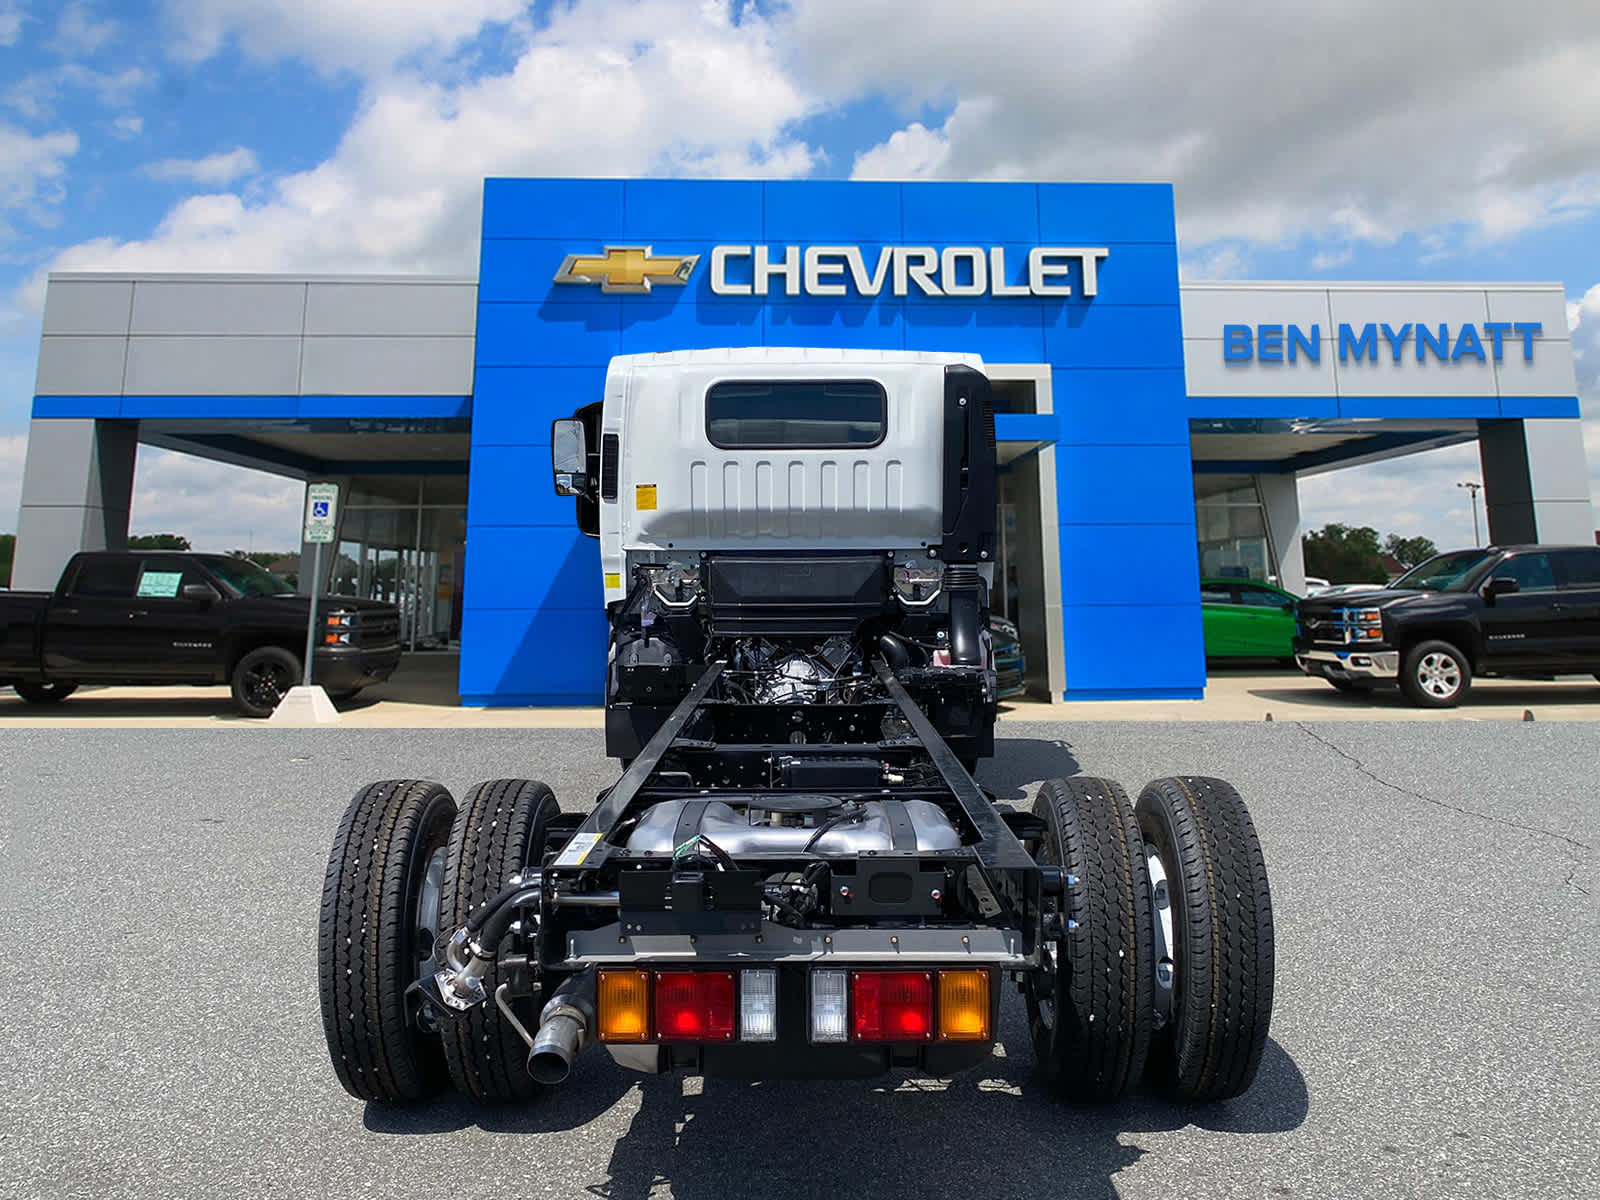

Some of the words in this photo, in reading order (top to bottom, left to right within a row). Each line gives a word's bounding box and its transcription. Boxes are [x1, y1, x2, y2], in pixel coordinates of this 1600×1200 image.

[710, 245, 1110, 297] CHEVROLET
[1223, 323, 1322, 363] BEN
[1338, 322, 1543, 363] MYNATT
